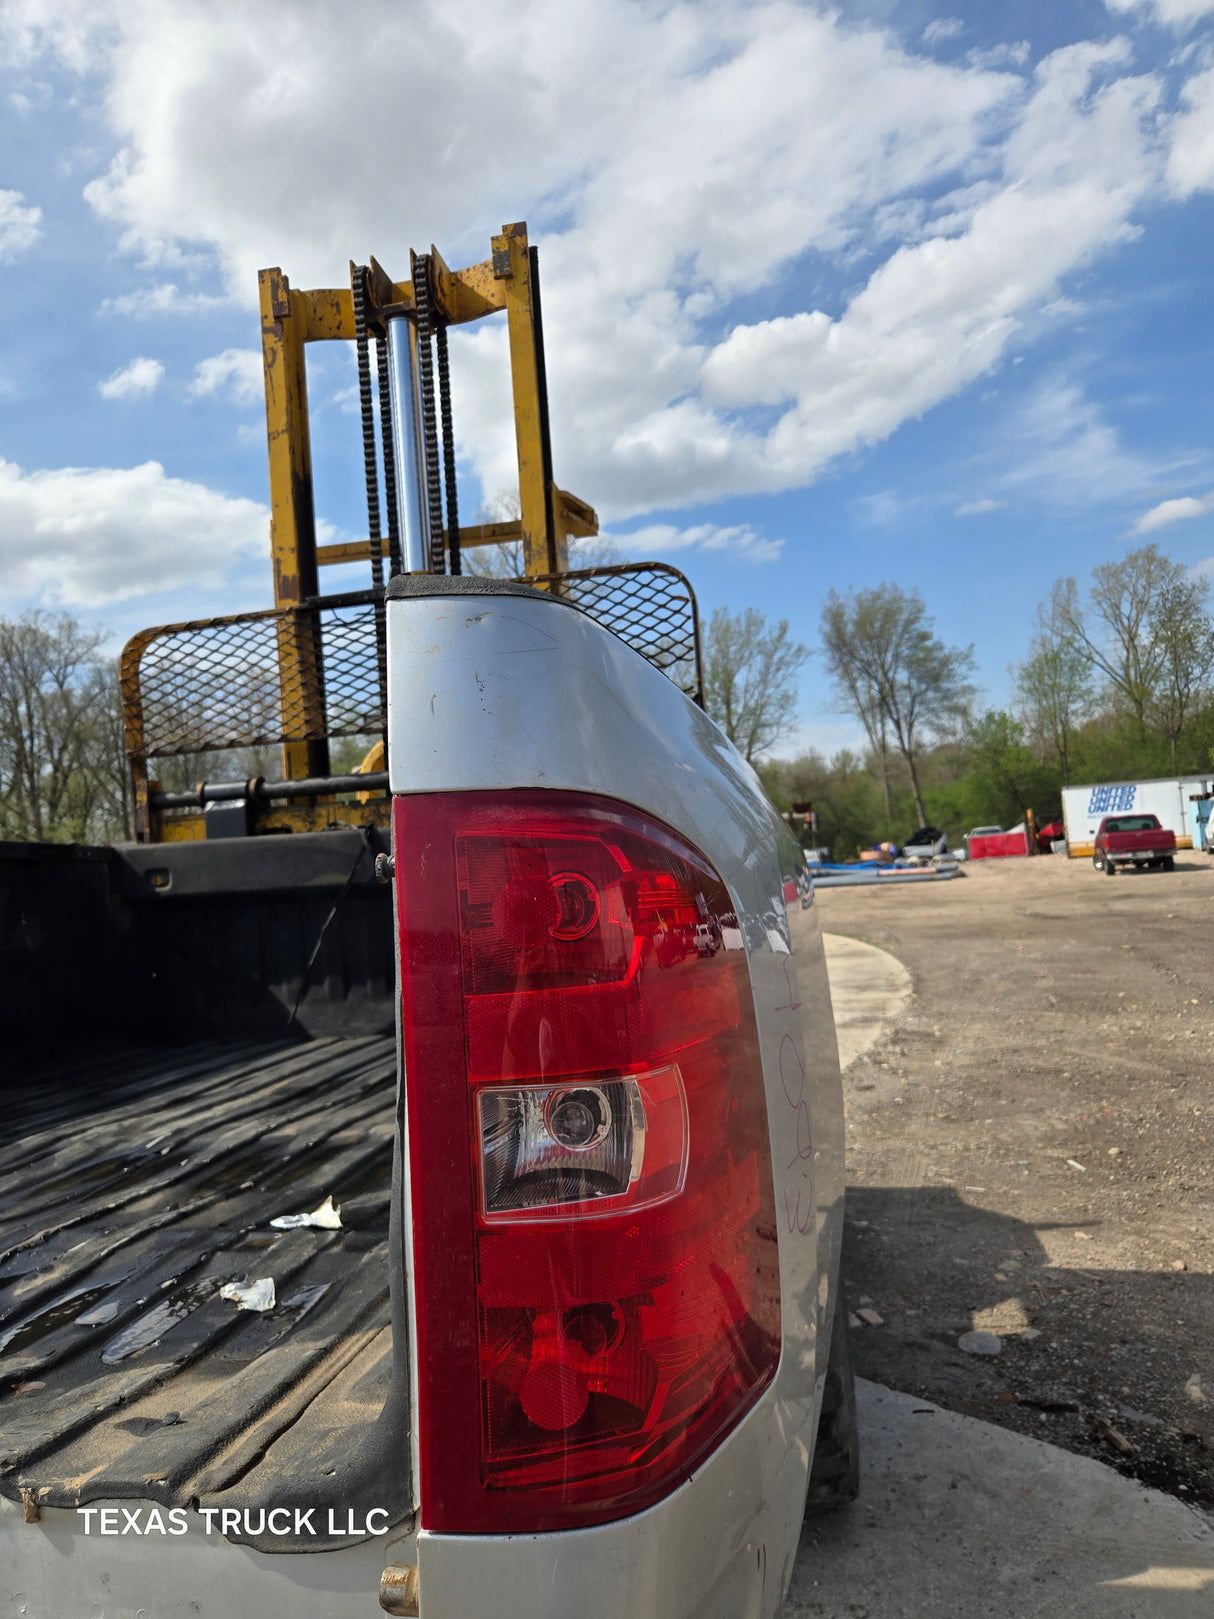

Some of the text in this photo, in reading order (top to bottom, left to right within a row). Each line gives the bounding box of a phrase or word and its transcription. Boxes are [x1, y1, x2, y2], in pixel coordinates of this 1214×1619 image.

[1092, 784, 1137, 797] UNITED
[1090, 794, 1135, 805] UNITED
[1088, 803, 1133, 813] UNITED
